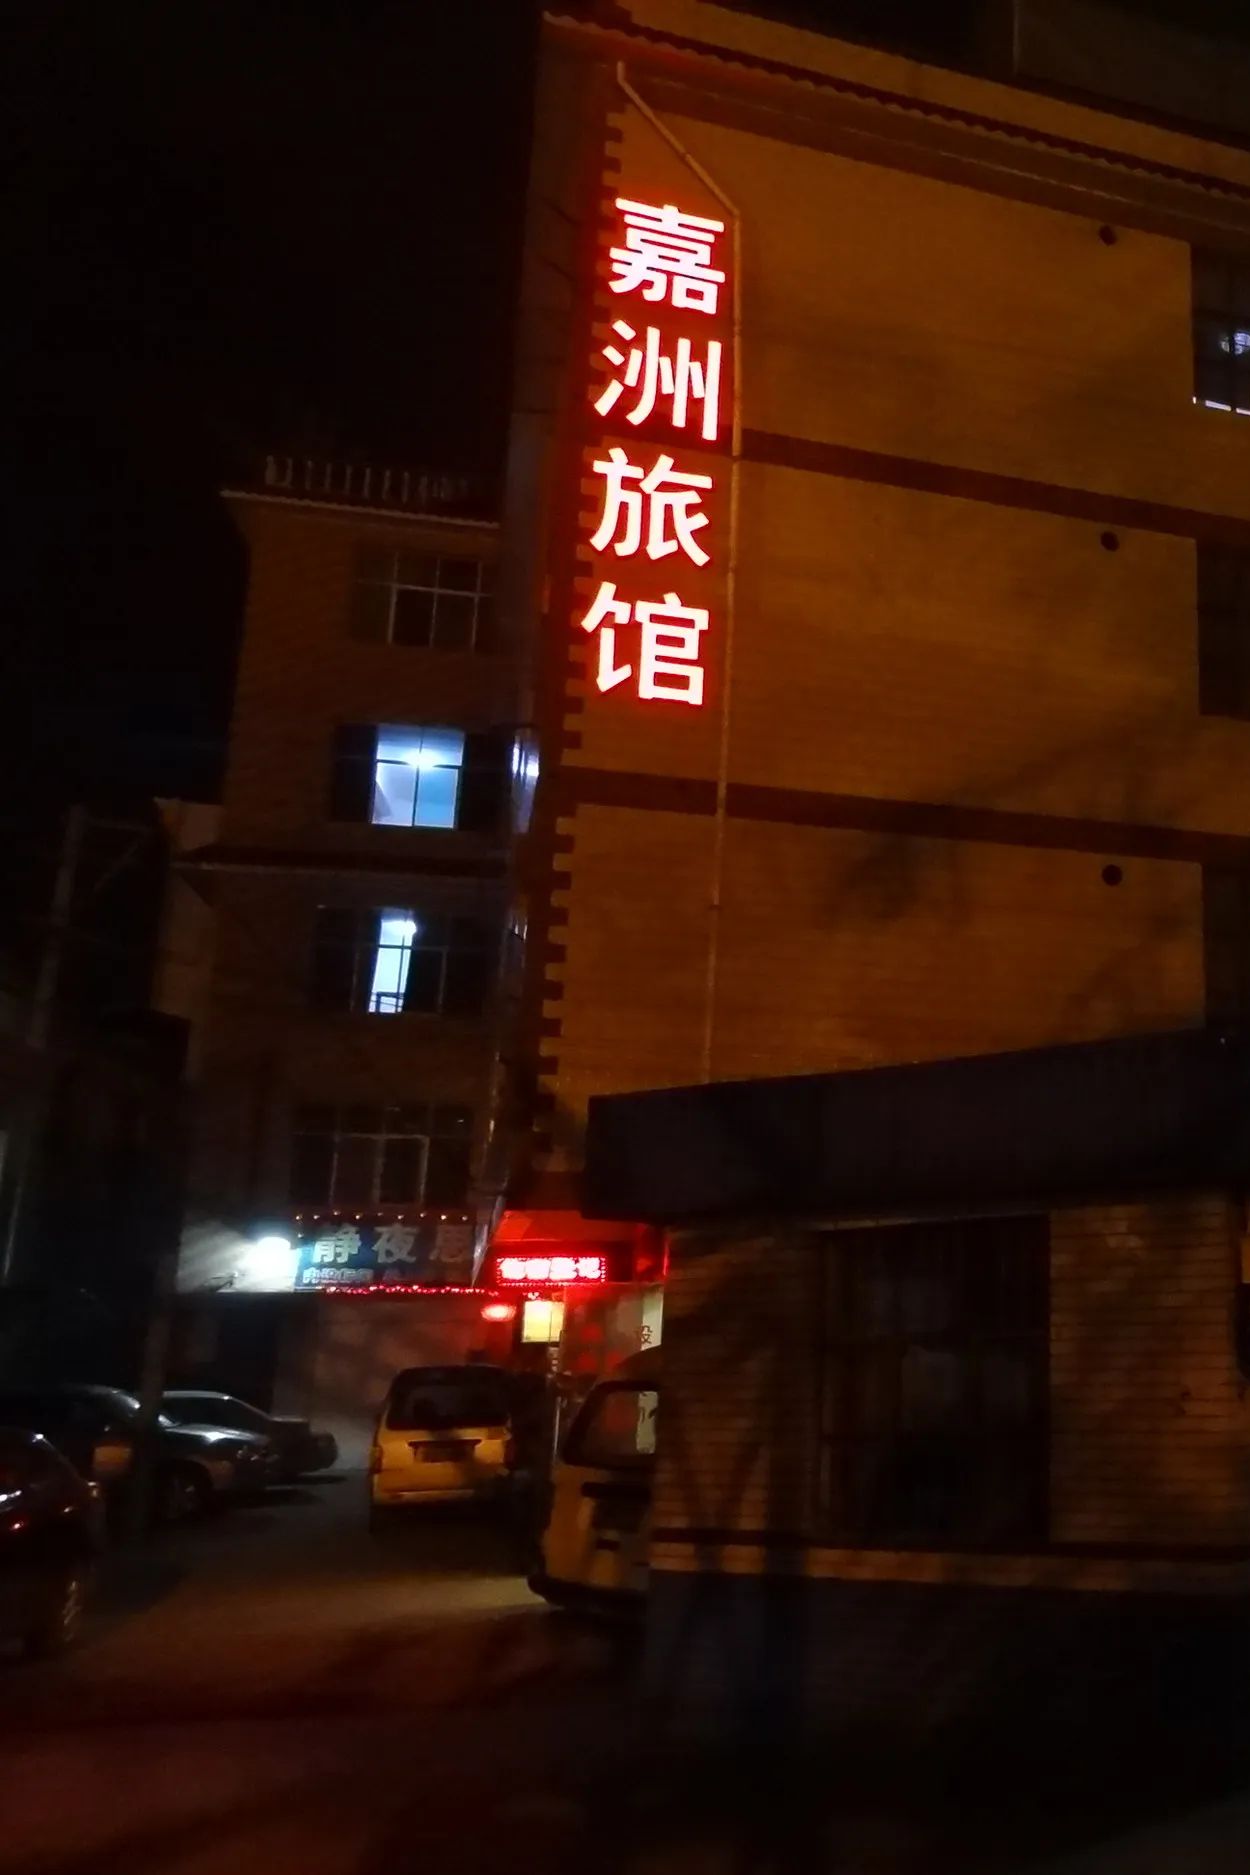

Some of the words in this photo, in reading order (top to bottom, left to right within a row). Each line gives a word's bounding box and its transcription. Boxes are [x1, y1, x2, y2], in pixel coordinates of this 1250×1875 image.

[581, 197, 727, 706] 嘉洲旅馆
[311, 1222, 472, 1263] 静夜思
